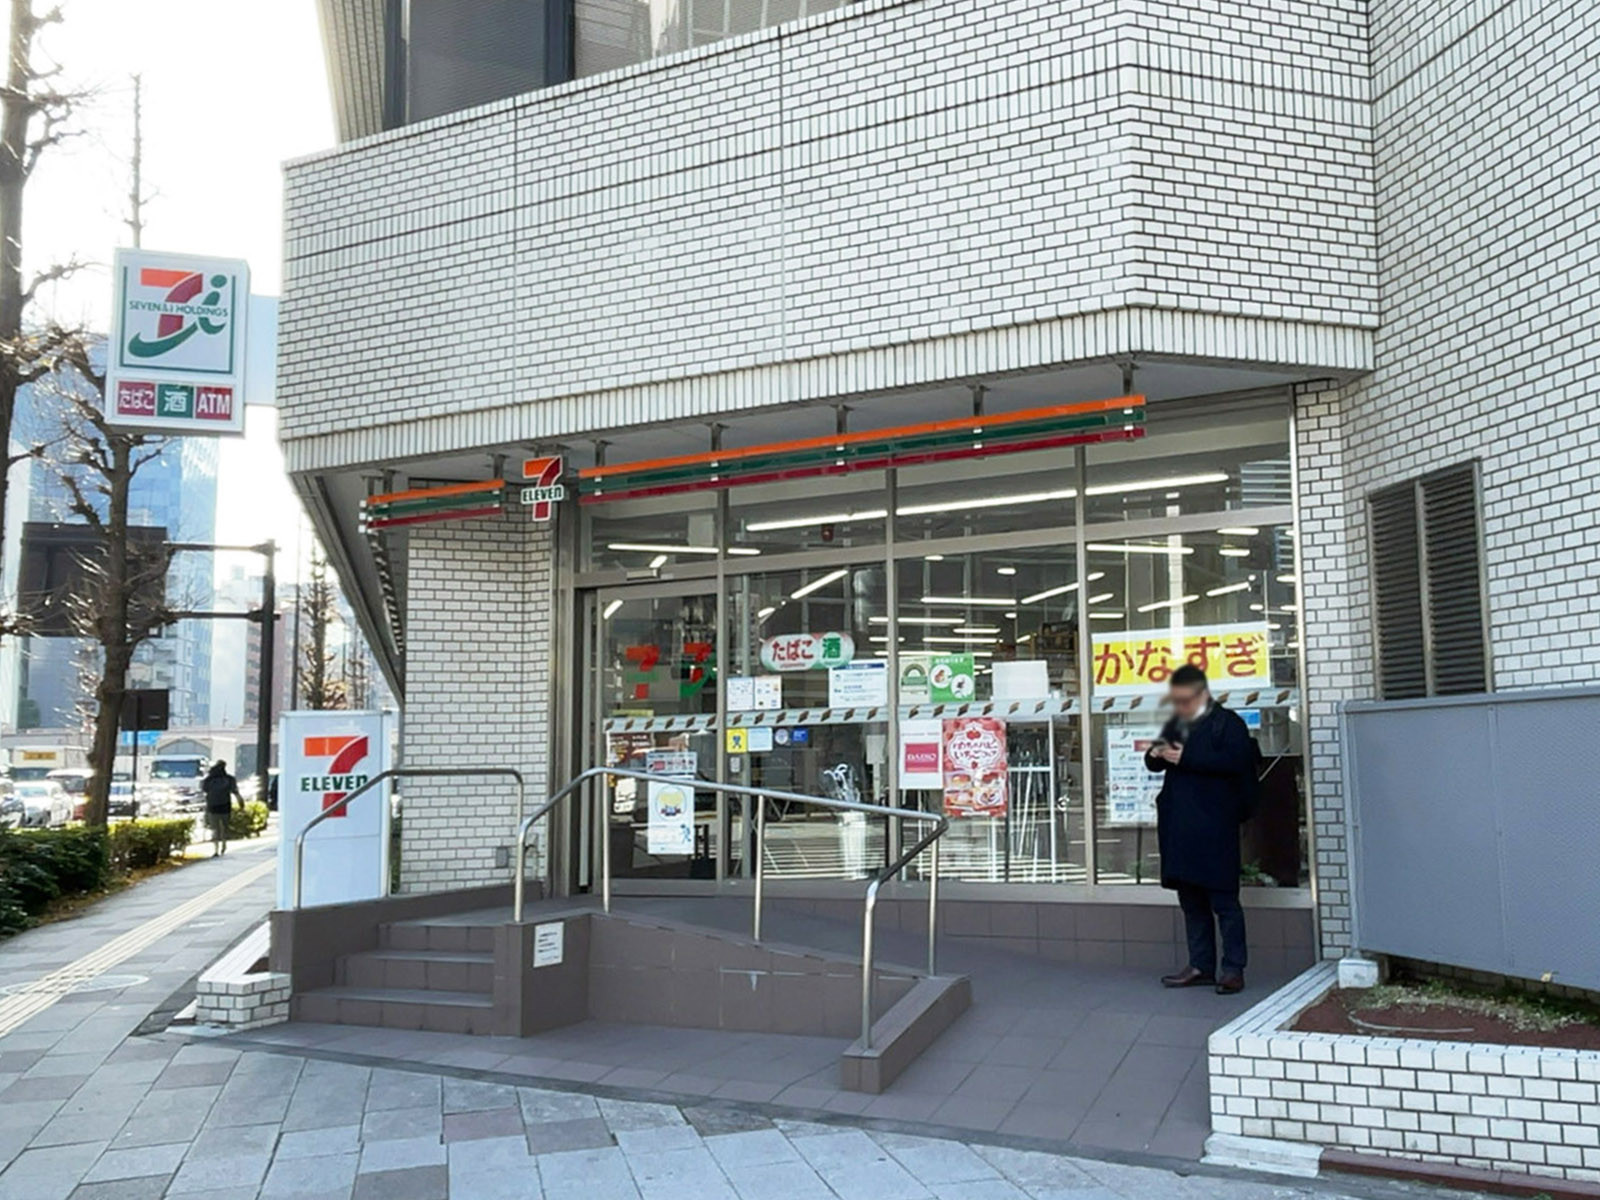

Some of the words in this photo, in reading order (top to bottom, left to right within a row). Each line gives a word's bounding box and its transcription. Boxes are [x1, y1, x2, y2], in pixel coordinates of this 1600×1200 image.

[176, 305, 228, 317] HOLDINGS
[119, 389, 155, 409] たばこ
[164, 391, 188, 412] 酒
[197, 394, 230, 414] ATM
[772, 639, 814, 661] たばこ
[822, 637, 841, 658] 酒
[1094, 634, 1265, 685] かなすぎ
